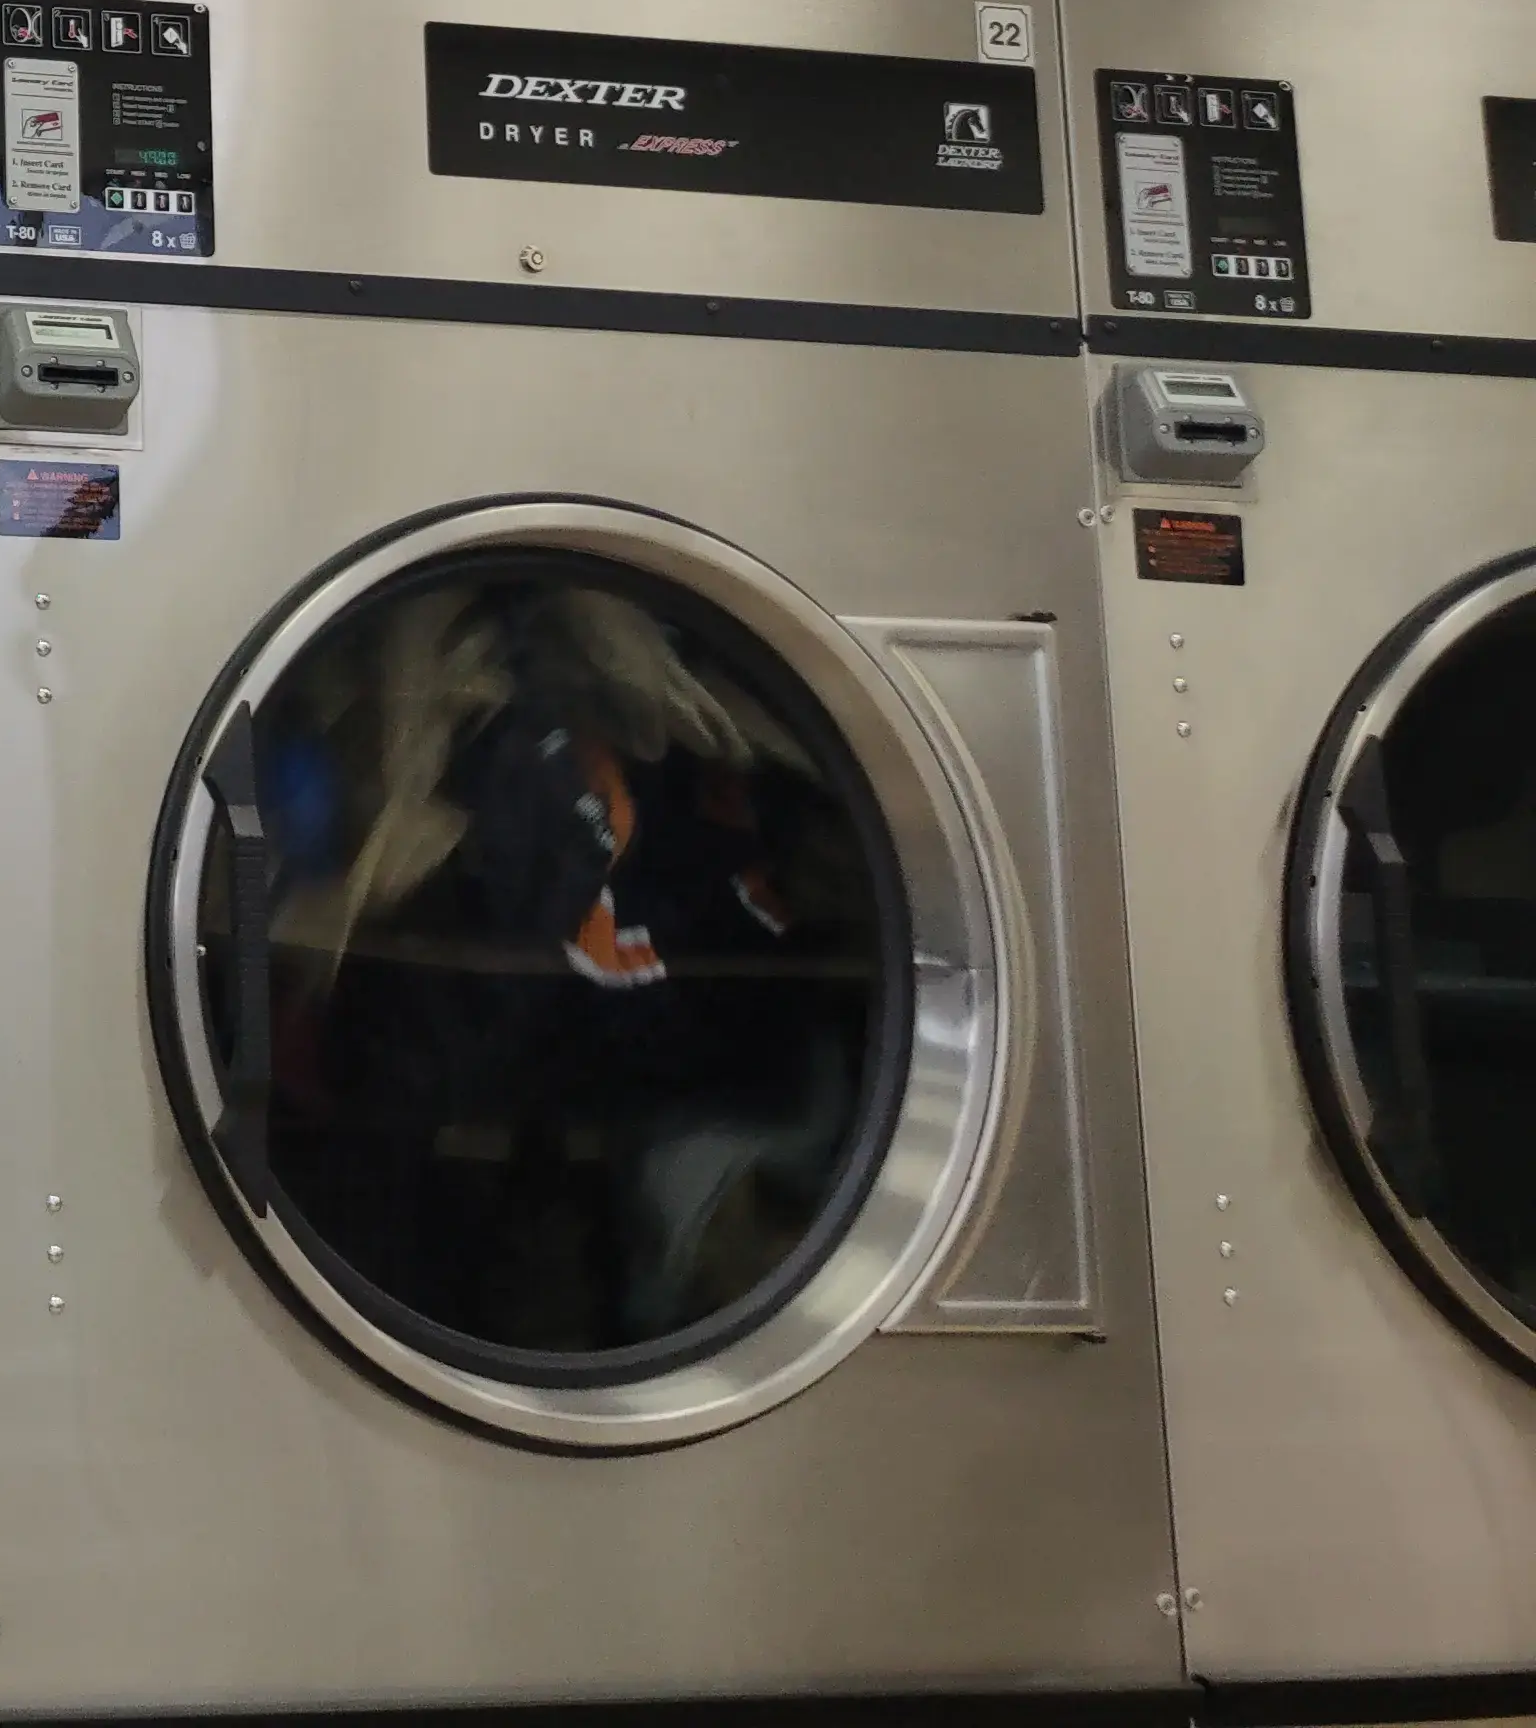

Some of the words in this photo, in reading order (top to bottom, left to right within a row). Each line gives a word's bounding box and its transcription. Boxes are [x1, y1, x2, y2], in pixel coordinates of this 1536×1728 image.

[989, 21, 1021, 47] 22
[478, 73, 688, 112] DEXTER
[479, 122, 595, 148] DRYER
[629, 134, 728, 156] EXPRESS
[5, 224, 36, 241] T-80
[151, 229, 163, 249] 8
[1126, 290, 1156, 306] T-80
[1255, 294, 1267, 311] 8
